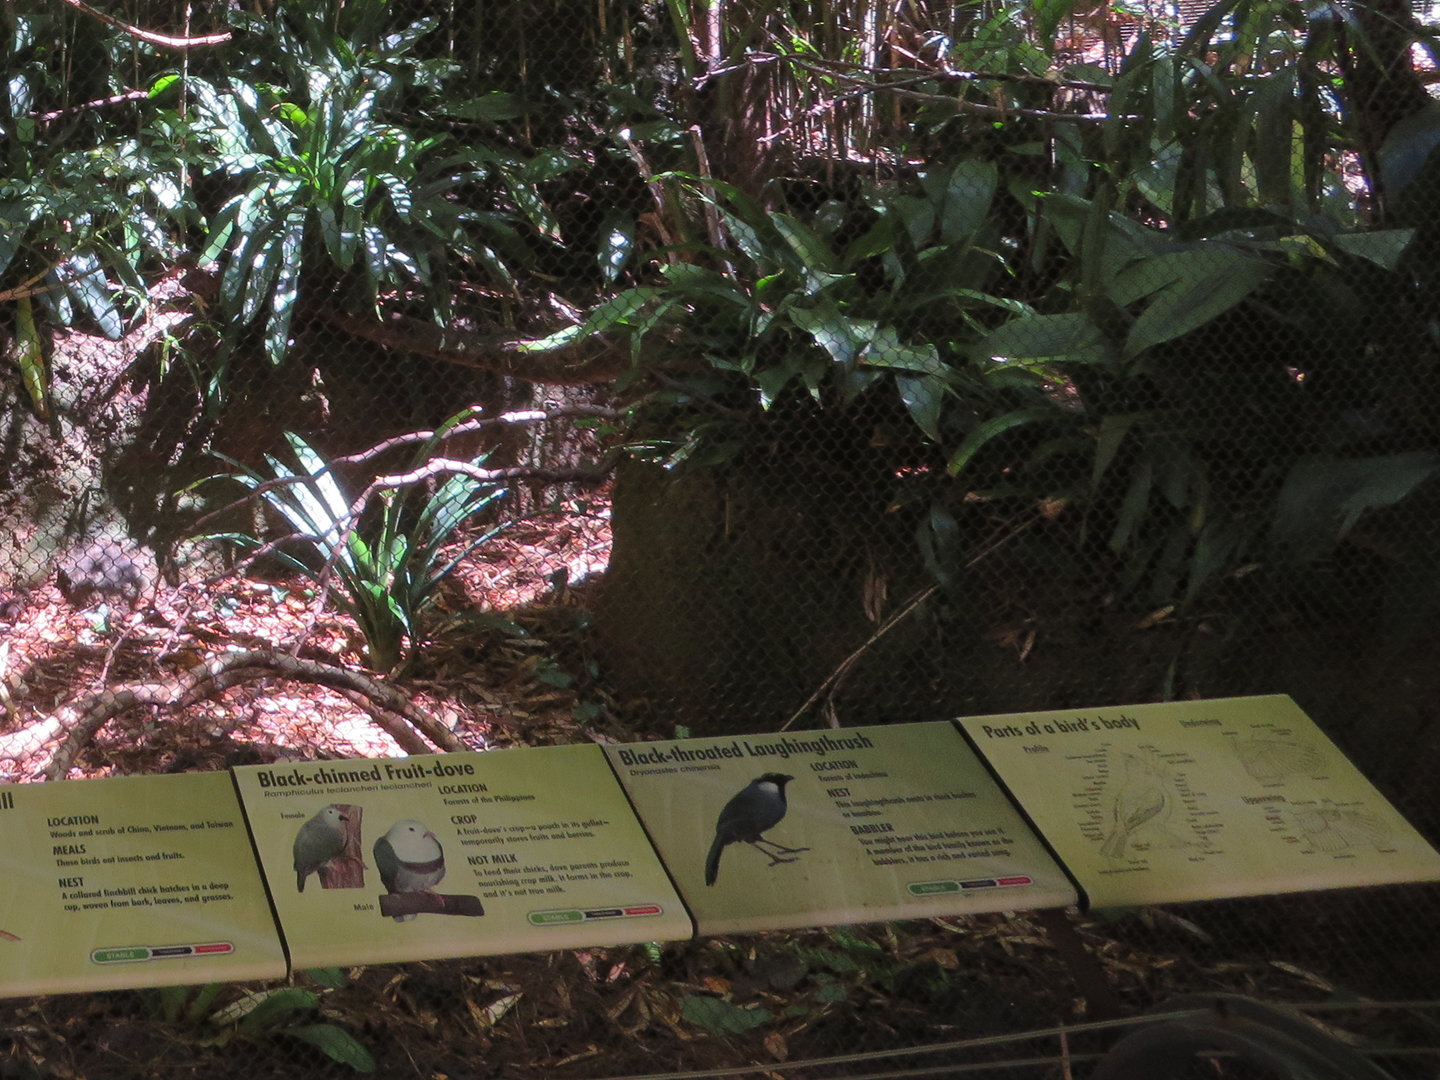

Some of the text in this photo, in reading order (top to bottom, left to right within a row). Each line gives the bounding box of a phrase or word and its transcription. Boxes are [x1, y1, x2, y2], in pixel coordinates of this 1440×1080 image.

[982, 714, 1141, 738] Parts of a bird's body
[619, 732, 874, 766] Black-throated Laughingthrush
[810, 760, 859, 772] LOCATION
[258, 760, 475, 789] Black-chinned Fruit-dove
[438, 783, 488, 795] LOCATION
[826, 787, 852, 798] NEST
[443, 793, 536, 806] Forests of the Philippines
[47, 814, 99, 828] LOCATION
[450, 814, 478, 825] CROP
[50, 820, 234, 839] Woods and scrub of China, Vietnam, and Taiwan
[849, 823, 895, 835] BABBLER
[53, 844, 86, 856] MEALS
[56, 851, 186, 867] These birds eat insects and fruits.
[467, 853, 518, 866] NOT MILK
[58, 876, 84, 889] NEST
[62, 892, 68, 900] A
[69, 889, 102, 899] collared
[103, 887, 136, 898] finchbill
[138, 886, 158, 895] chick
[159, 883, 190, 893] hatches
[192, 882, 200, 891] in
[209, 881, 229, 891] deep
[64, 894, 234, 912] cup, woven from bark, leaves, and grasses.
